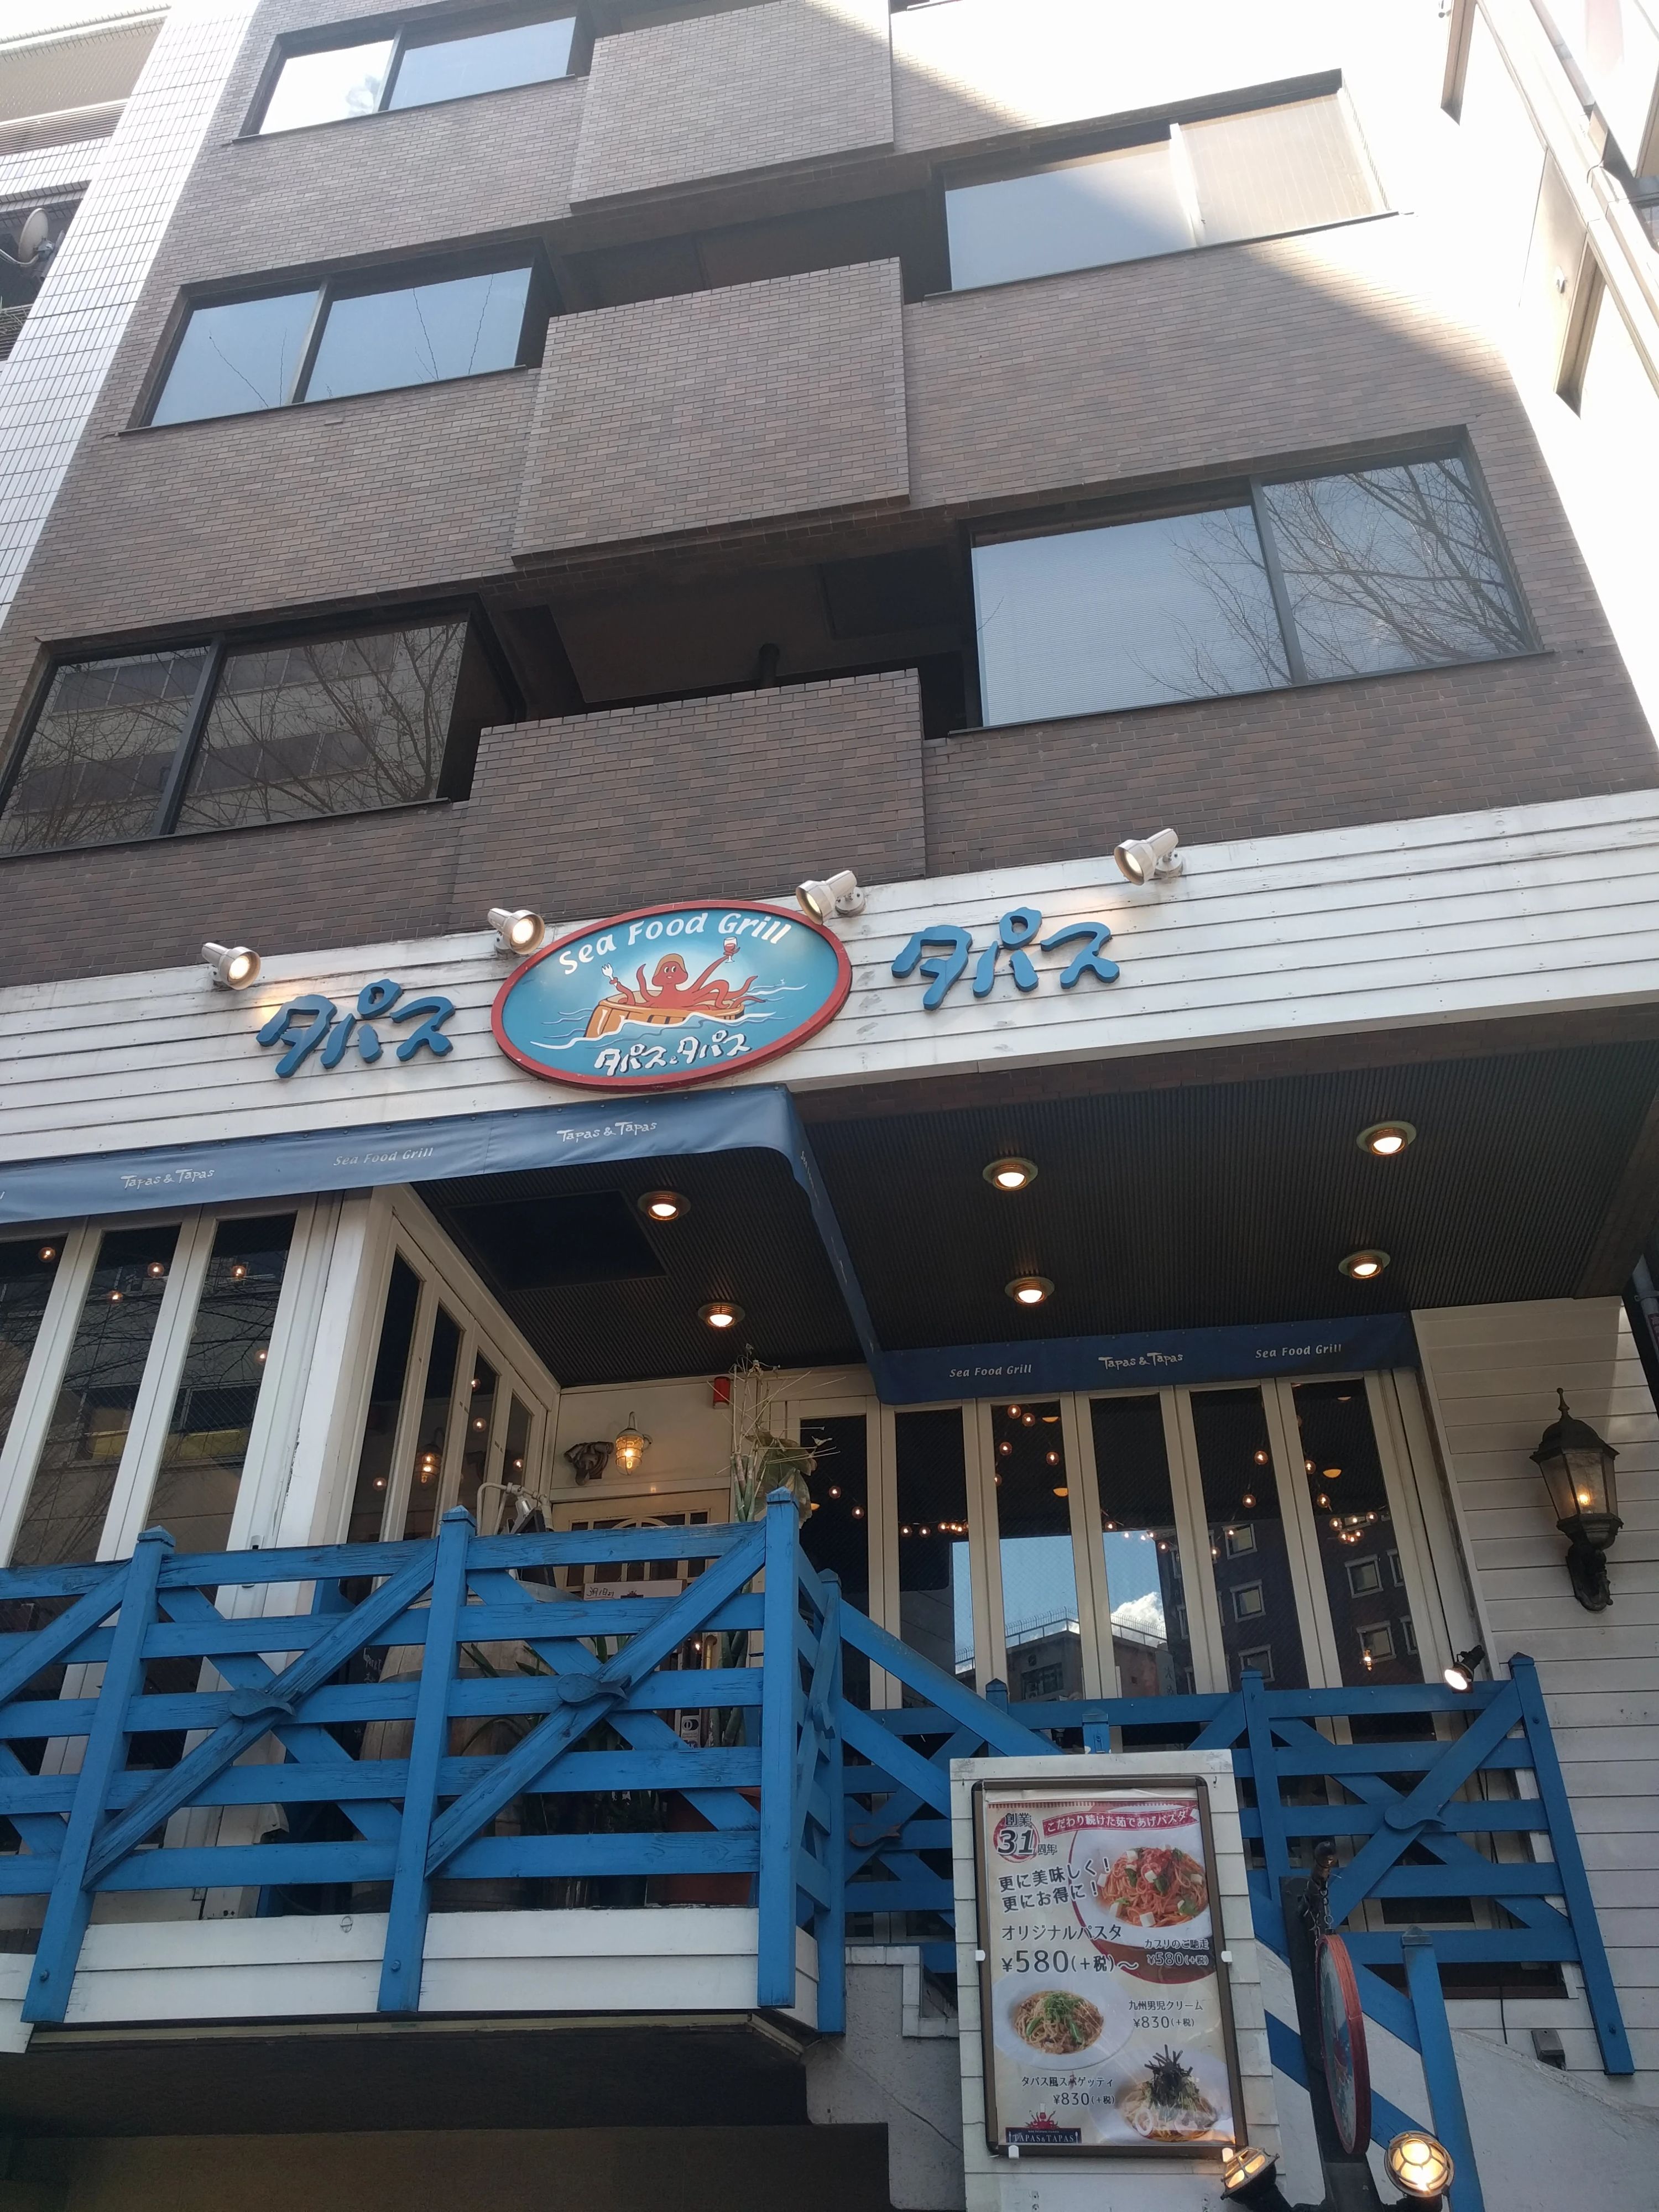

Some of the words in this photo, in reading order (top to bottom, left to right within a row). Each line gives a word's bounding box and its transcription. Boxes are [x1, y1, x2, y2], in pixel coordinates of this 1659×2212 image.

[559, 934, 617, 975] Sea
[628, 913, 708, 946] Food
[718, 913, 791, 945] Grill
[891, 906, 1120, 1011] タパス
[255, 978, 455, 1078] タパス
[556, 1129, 601, 1143] Tapas
[603, 1127, 616, 1136] &
[615, 1121, 657, 1135] Tapas
[333, 1156, 359, 1166] Sea
[363, 1152, 398, 1164] Food
[402, 1147, 434, 1160] Grill
[121, 1175, 161, 1190] Tapas
[163, 1174, 175, 1183] &
[175, 1169, 215, 1183] Tapas
[1255, 1349, 1276, 1359] Sea
[1282, 1345, 1311, 1356] Food
[1316, 1344, 1342, 1354] Grill
[1098, 1357, 1136, 1370] Tapas
[1139, 1357, 1151, 1365] &
[1147, 1352, 1183, 1366] Tapas
[950, 1368, 969, 1378] Sea
[974, 1366, 1002, 1376] Food
[1006, 1364, 1032, 1375] Grill
[1005, 1813, 1032, 1828] 創業
[1001, 1924, 1122, 1941] オリジナルパスタ
[1129, 2000, 1203, 2011] 九州男児クリーム
